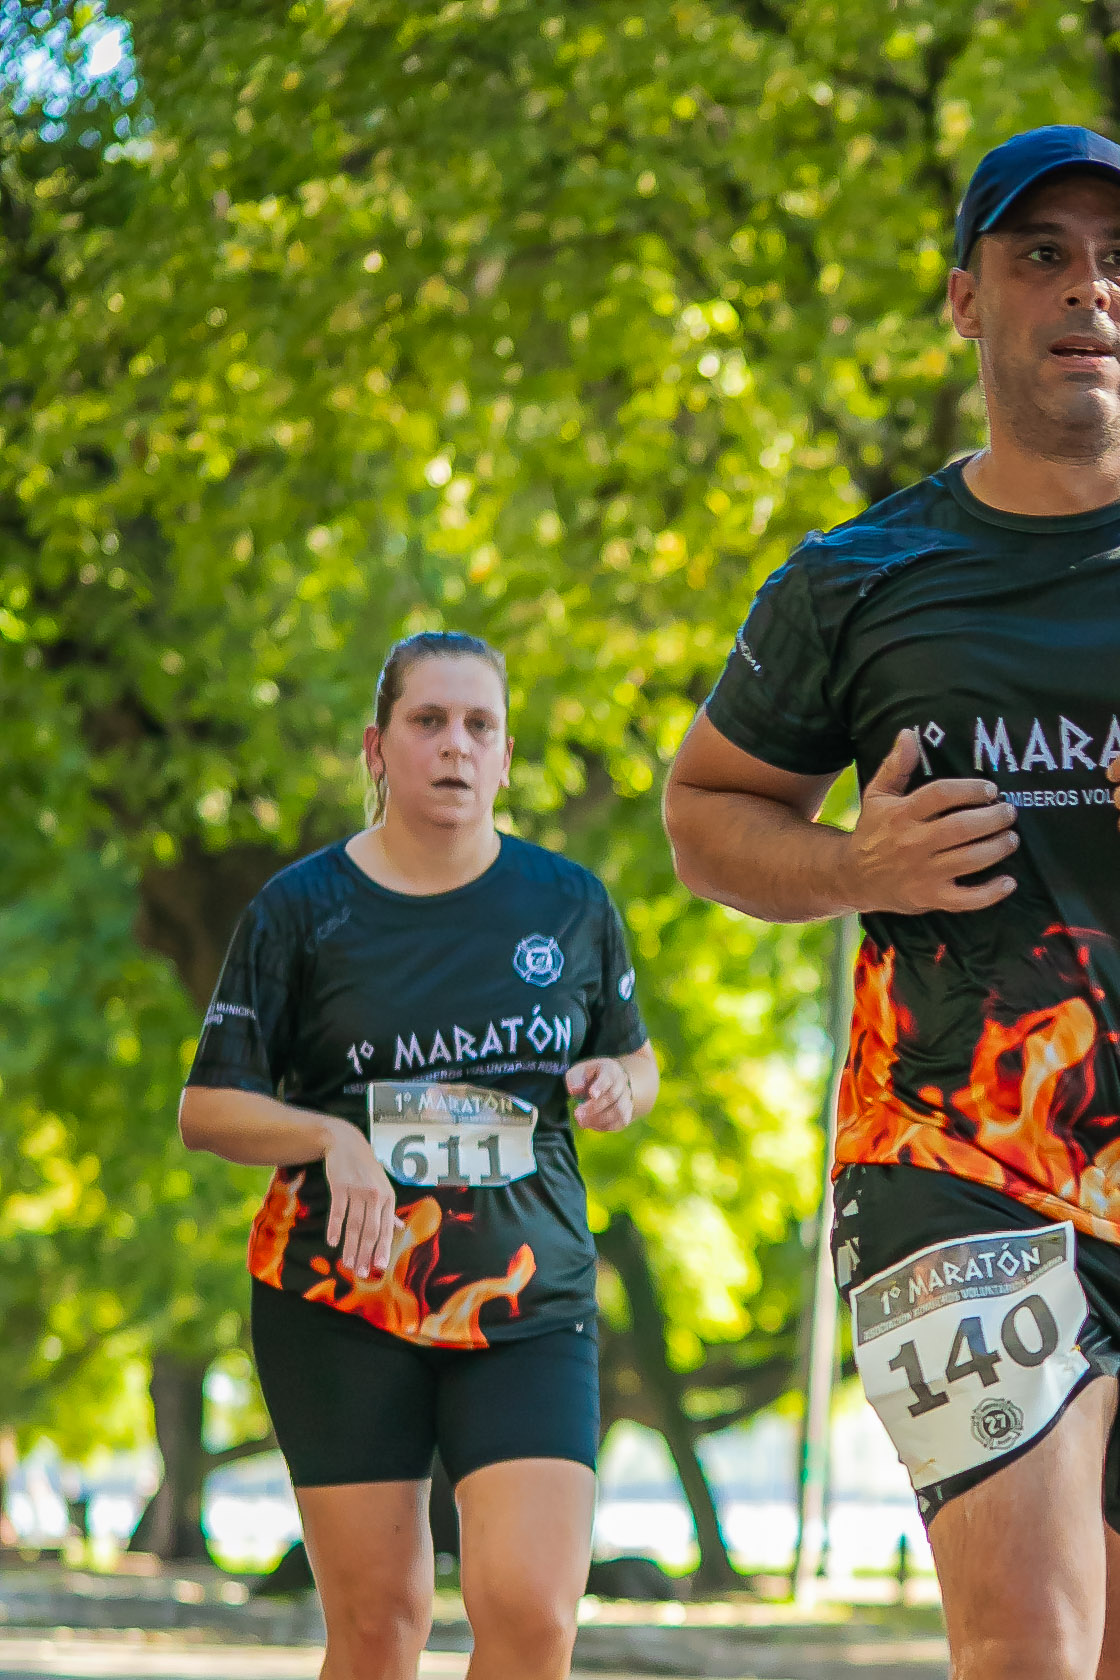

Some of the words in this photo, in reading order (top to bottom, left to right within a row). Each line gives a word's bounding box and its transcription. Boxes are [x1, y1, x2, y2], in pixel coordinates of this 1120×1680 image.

[394, 1003, 572, 1071] MARATÓN
[391, 1133, 511, 1186] 611
[908, 1242, 1041, 1304] MARATÓN
[888, 1294, 1059, 1417] 140
[984, 1413, 1006, 1435] 27
